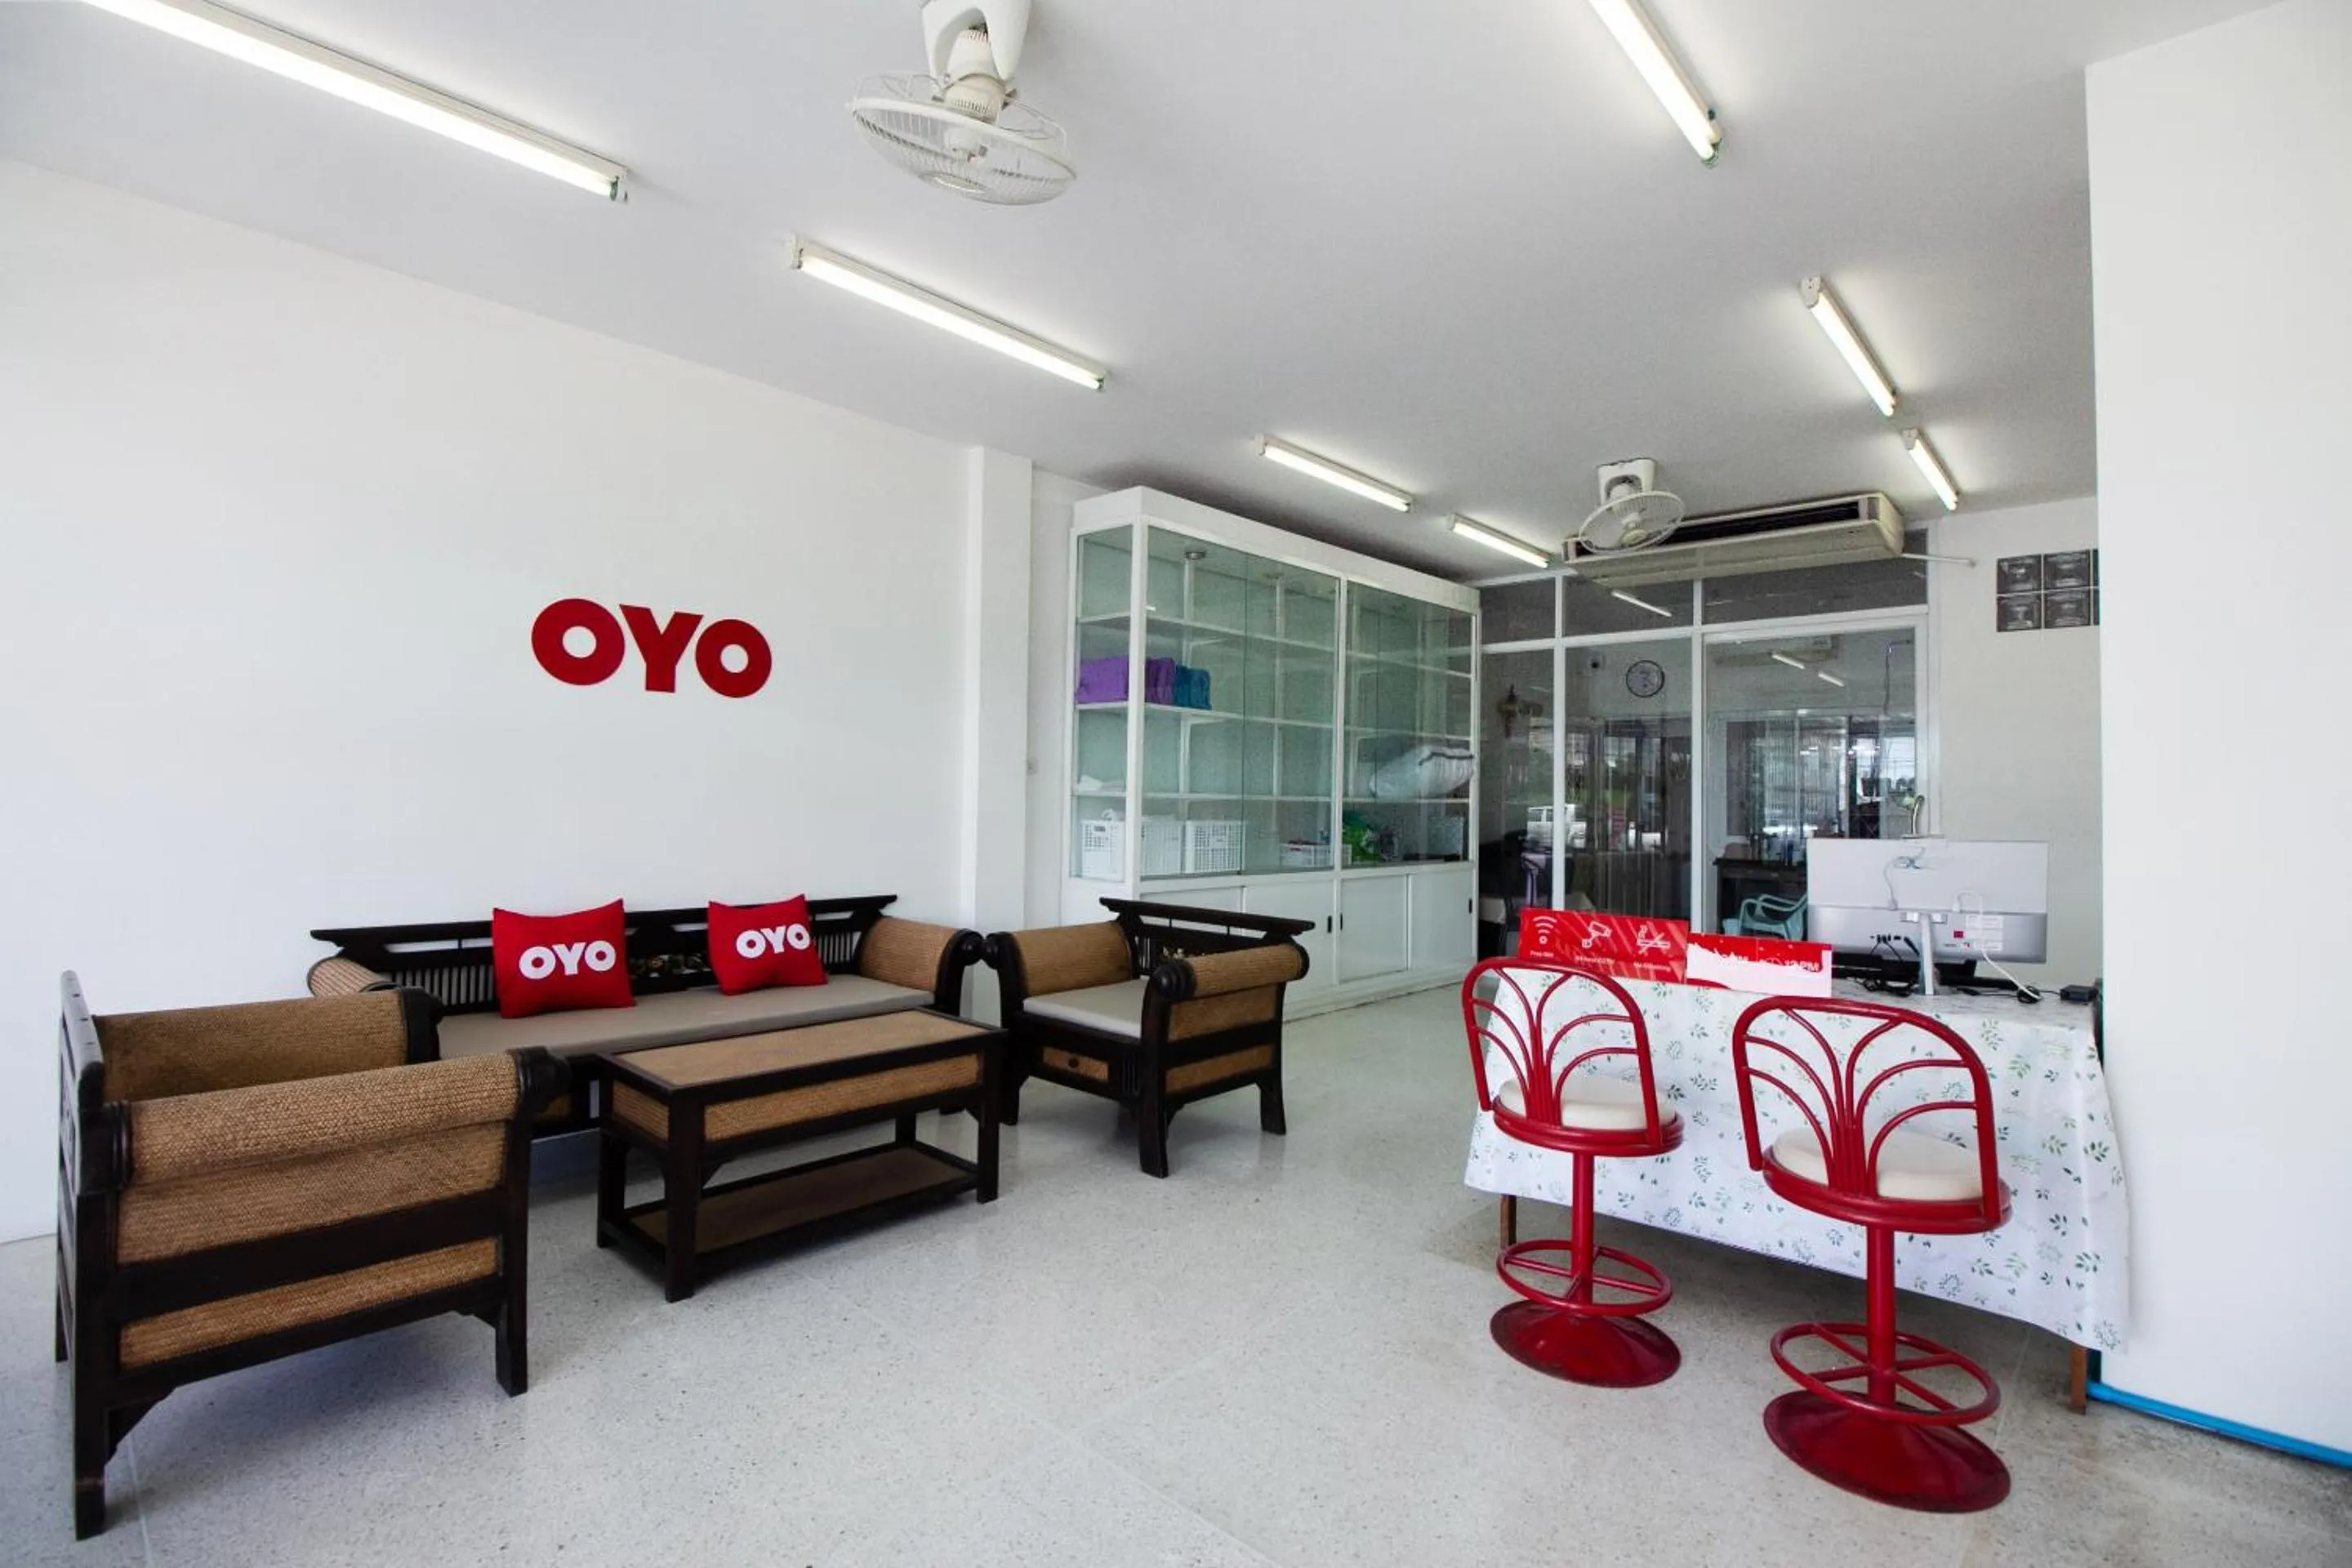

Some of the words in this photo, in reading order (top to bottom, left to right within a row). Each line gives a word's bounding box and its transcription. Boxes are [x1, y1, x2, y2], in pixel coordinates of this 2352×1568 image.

[532, 598, 772, 697] OYO
[519, 940, 616, 979] OYO
[735, 923, 810, 959] OYO
